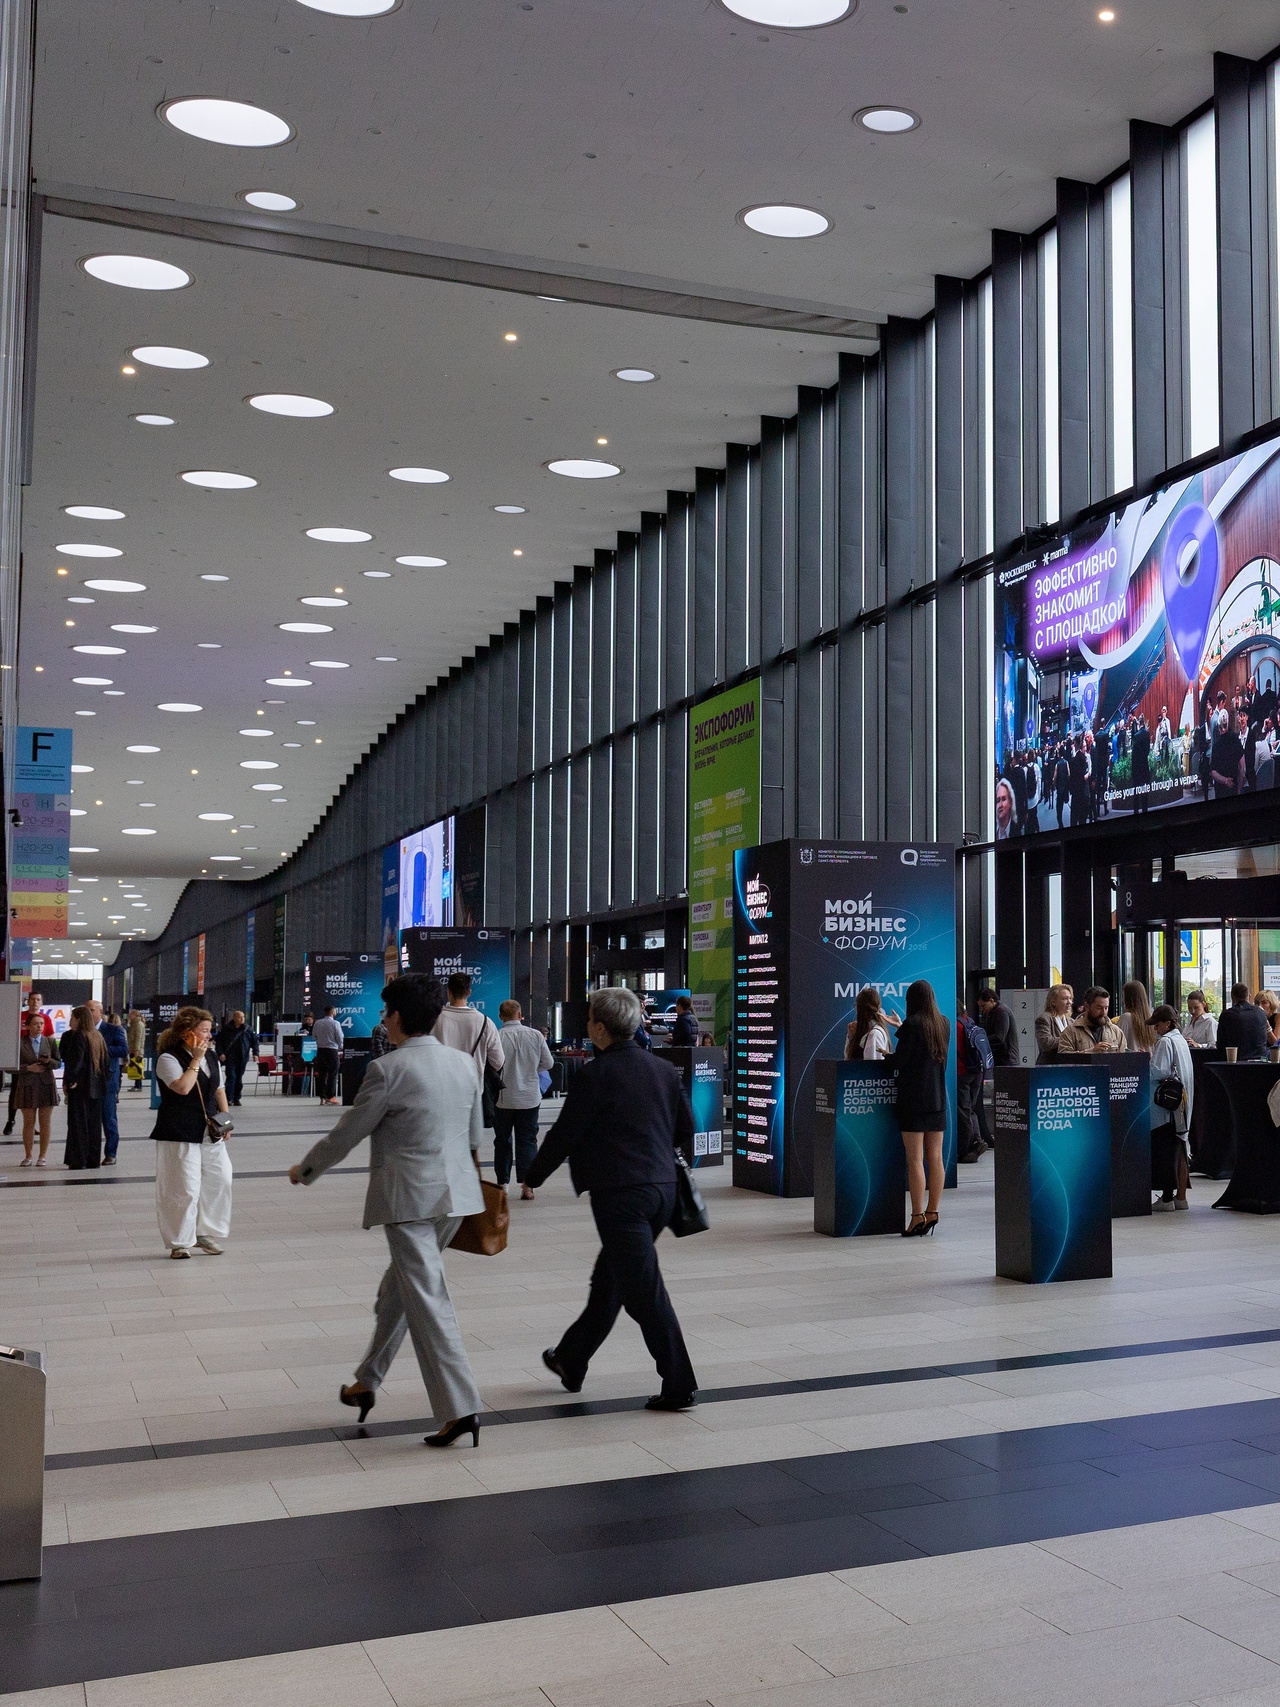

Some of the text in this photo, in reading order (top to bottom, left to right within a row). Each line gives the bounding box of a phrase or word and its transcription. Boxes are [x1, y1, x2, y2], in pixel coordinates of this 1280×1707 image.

[1034, 547, 1117, 598] ЭФФЕКТИВНО
[1035, 580, 1100, 624] ЗНАКОМИТ
[1035, 594, 1126, 650] С ПЛОЩАДКОЙ
[695, 701, 754, 744] ЭКСПОФОРУМ
[32, 732, 54, 761] F
[1104, 774, 1198, 801] Guides your route through a venue
[746, 873, 760, 893] МОЙ
[746, 892, 767, 906] БИЗНЕС
[825, 891, 872, 914] МОЙ
[1126, 892, 1132, 907] 8
[825, 917, 906, 932] БИЗНЕС
[835, 935, 907, 950] ФОРУМ
[434, 953, 462, 966] МОЙ
[326, 972, 347, 981] МОЙ
[434, 967, 481, 975] БИЗНЕС
[834, 982, 913, 998] МИТАП
[341, 1017, 353, 1028] 4
[695, 1061, 708, 1069] МОЙ
[844, 1079, 894, 1087] ГЛАВНОЕ
[844, 1087, 898, 1098] ДЕЛОВОЕ
[1037, 1086, 1096, 1098] ГЛАВНОЕ
[844, 1096, 897, 1105] СОБЫТИЕ
[1037, 1097, 1099, 1110] ДЕЛОВОЕ
[844, 1106, 874, 1115] ГОДА
[1037, 1108, 1100, 1119] СОБЫТИЕ
[1037, 1120, 1072, 1131] ГОДА
